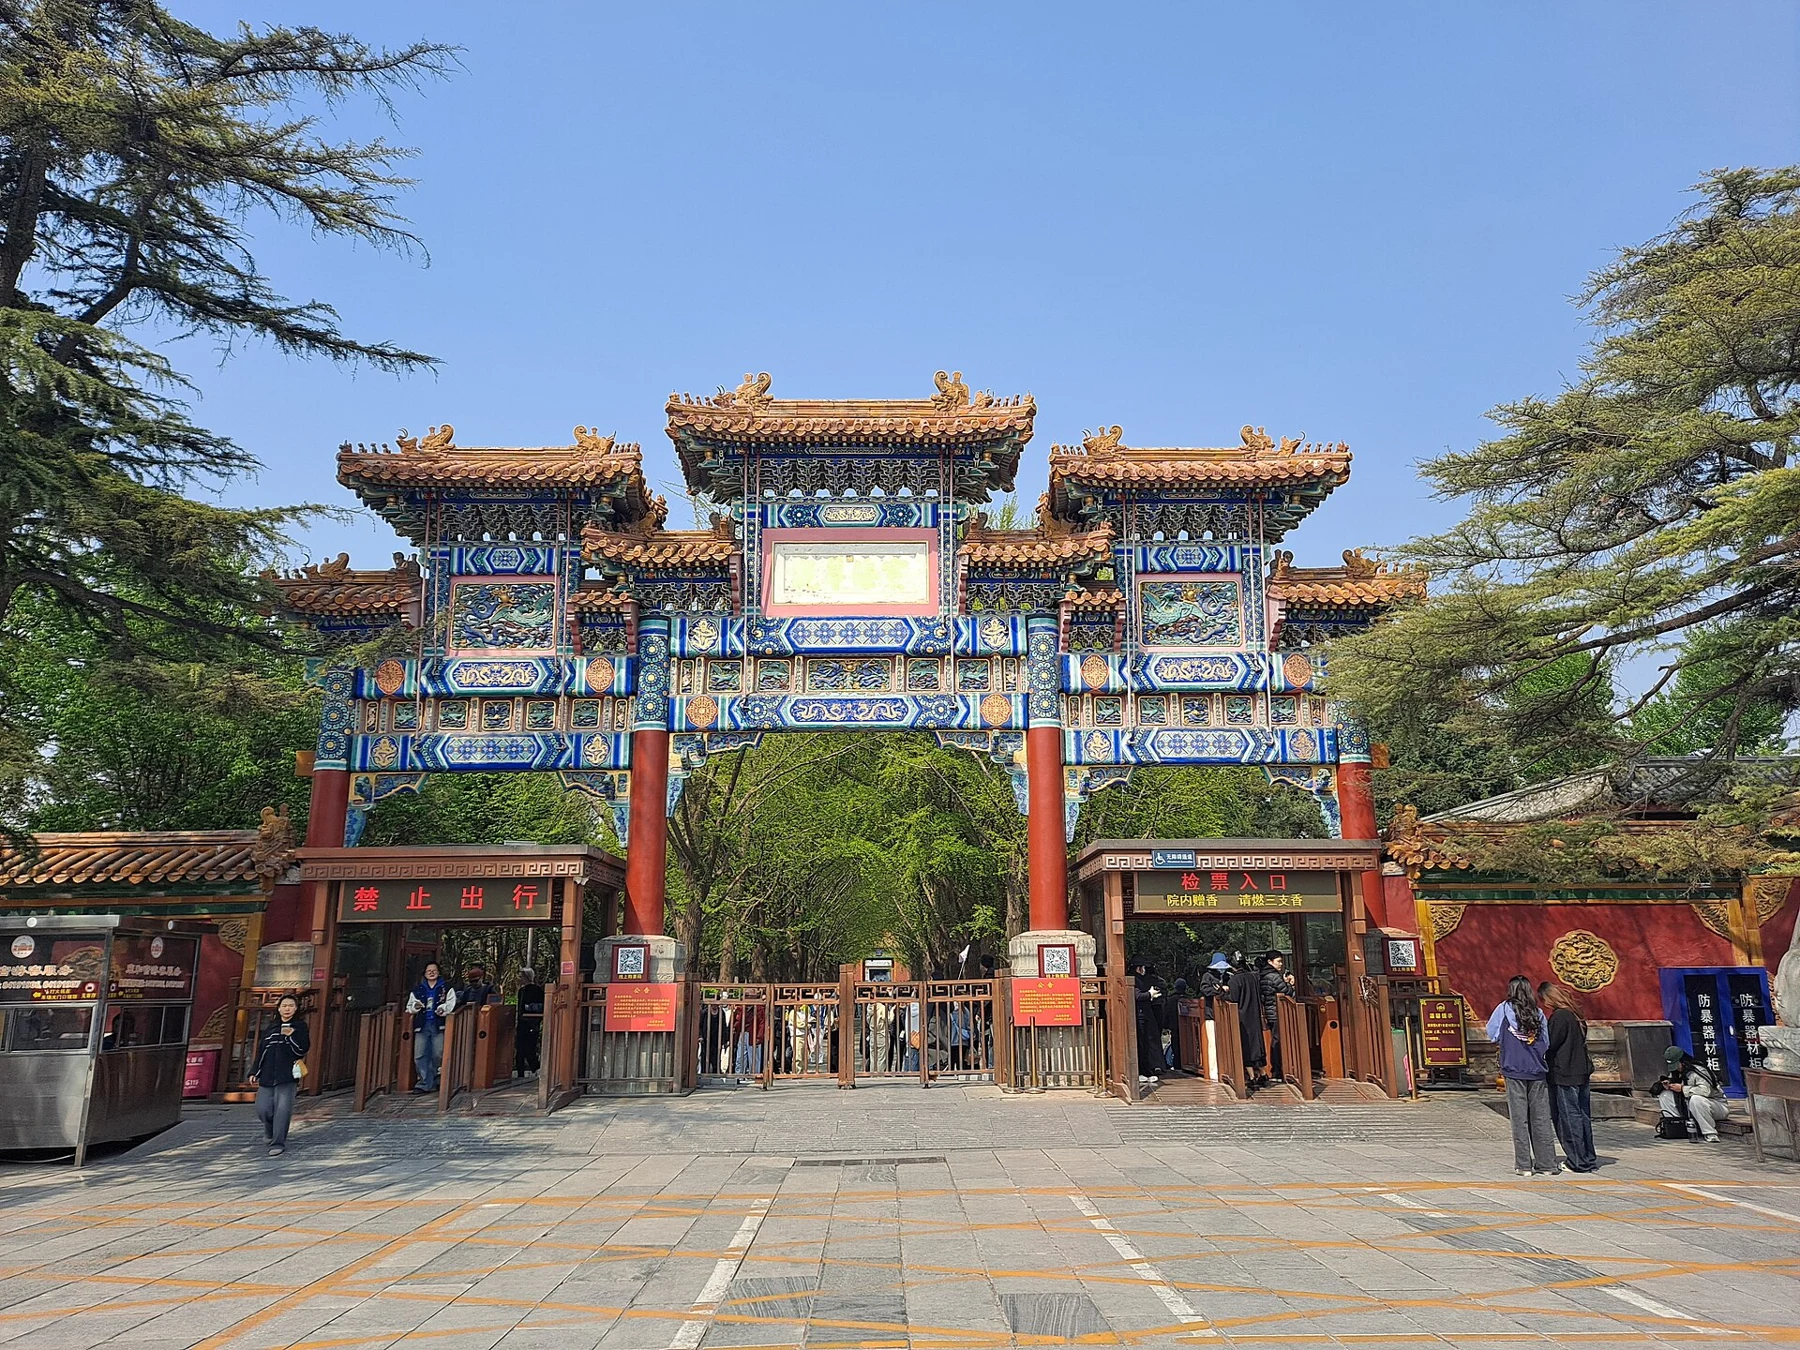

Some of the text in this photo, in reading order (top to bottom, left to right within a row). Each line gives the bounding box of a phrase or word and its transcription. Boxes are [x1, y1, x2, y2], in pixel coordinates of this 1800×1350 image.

[1181, 872, 1287, 891] 检票入口
[353, 884, 539, 912] 禁止出行
[1166, 893, 1303, 907] 院内赠香 请燃三支香
[1698, 994, 1721, 1071] 防暴器材柜
[1740, 994, 1762, 1068] 防暴器材柜
